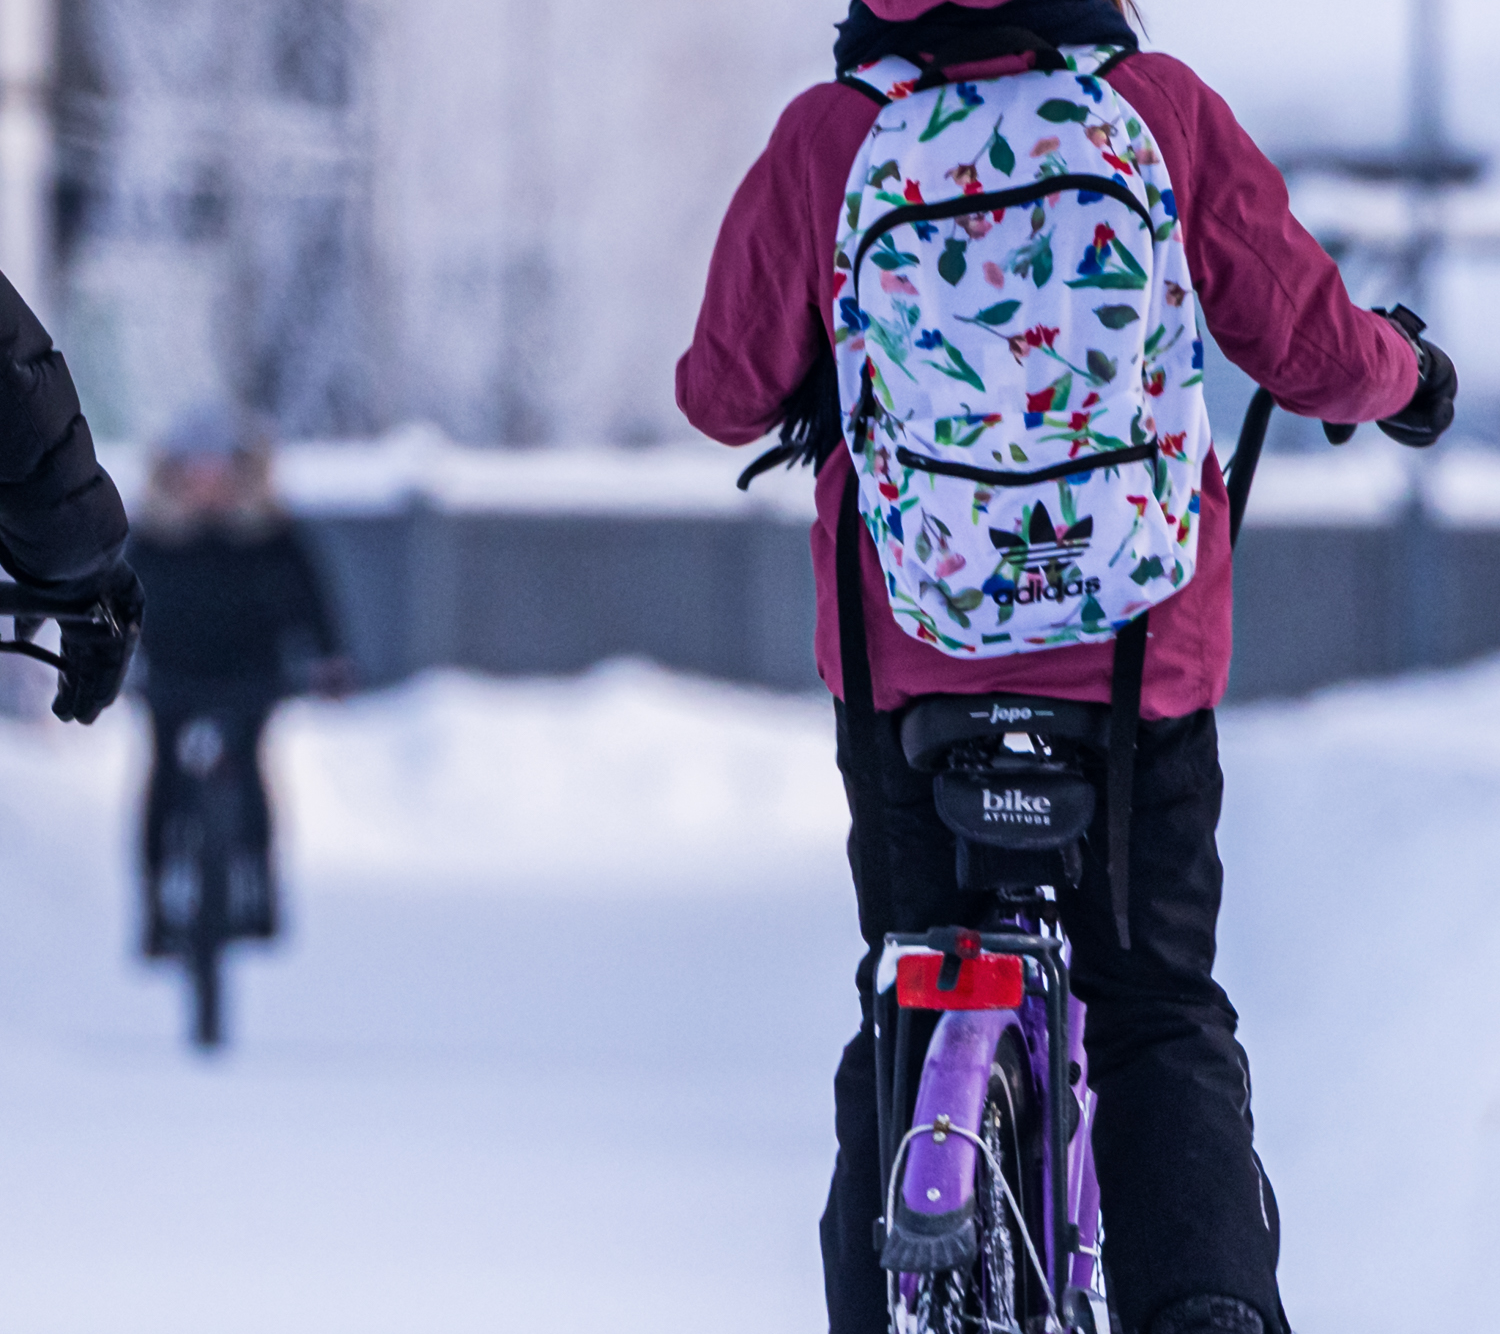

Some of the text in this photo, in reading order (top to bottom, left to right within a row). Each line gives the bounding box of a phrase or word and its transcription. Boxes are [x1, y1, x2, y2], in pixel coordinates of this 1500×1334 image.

[991, 574, 1101, 606] adidas
[989, 703, 1033, 725] jopo
[982, 788, 1052, 815] bike
[983, 811, 1052, 826] ATTITUDE
